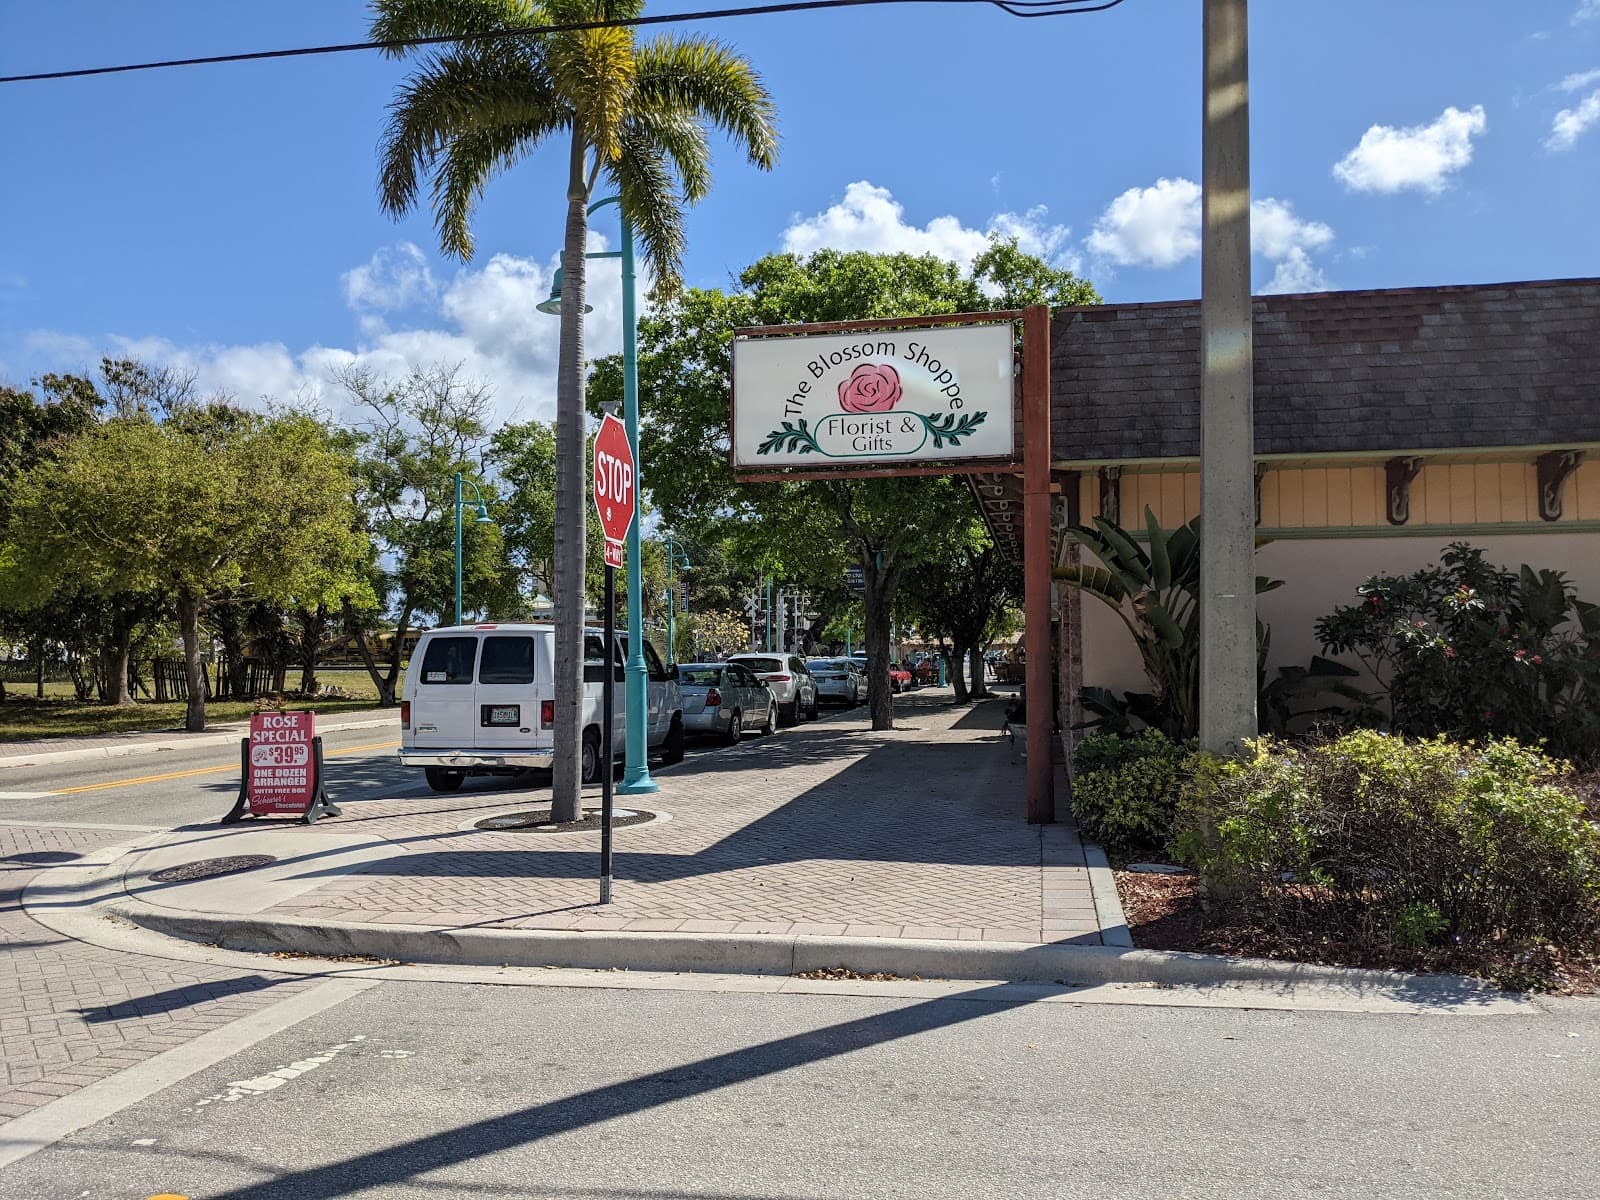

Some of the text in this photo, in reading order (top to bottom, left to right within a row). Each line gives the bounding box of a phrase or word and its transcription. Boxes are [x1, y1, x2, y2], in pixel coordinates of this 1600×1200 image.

[784, 341, 964, 417] The Blossom Shoppe
[829, 416, 916, 436] Florist &
[852, 435, 893, 452] Gifts
[597, 451, 632, 505] STOP
[263, 716, 299, 728] ROSE
[252, 730, 308, 743] SPECIAL
[254, 768, 306, 777] ONE DOZEN
[254, 778, 306, 786] ARRANGED
